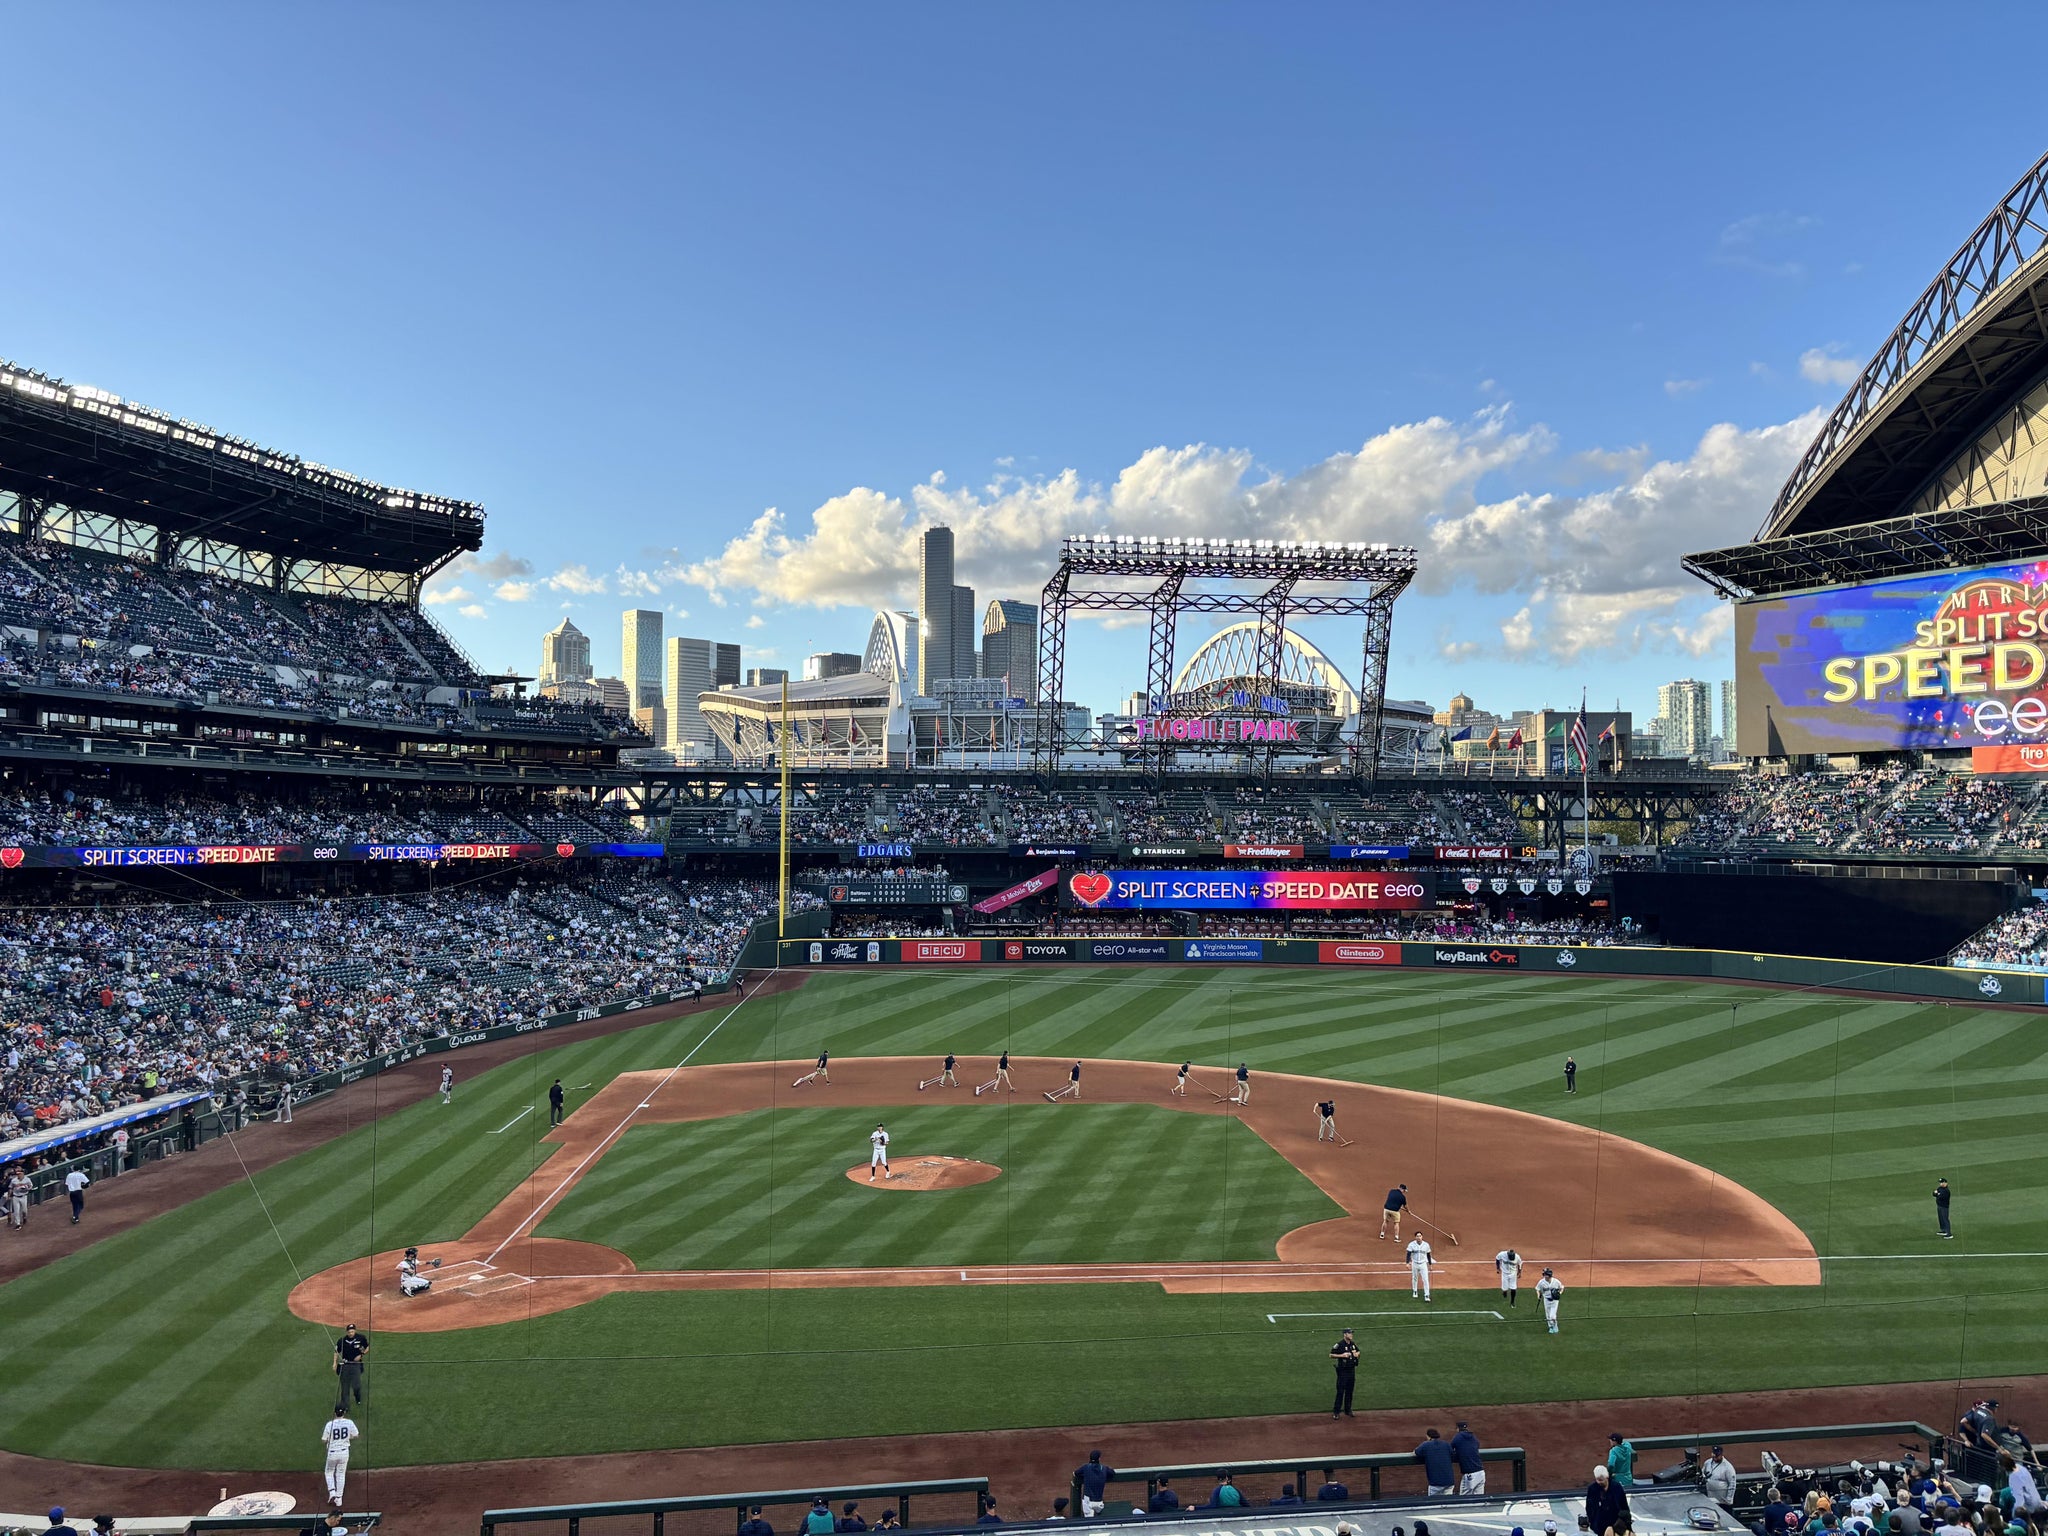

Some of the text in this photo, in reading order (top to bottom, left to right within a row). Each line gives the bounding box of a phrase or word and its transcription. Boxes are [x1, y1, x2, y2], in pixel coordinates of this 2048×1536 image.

[1916, 612, 2010, 647] SPLIT
[1824, 642, 2046, 702] SPEED
[1233, 690, 1289, 716] MARINERS
[514, 709, 537, 718] Trident
[1134, 719, 1300, 741] T-MOBILE PARK
[2020, 747, 2043, 759] fire
[84, 848, 275, 866] SPLIT SCREEN SPEED DATE
[314, 847, 338, 859] eero
[369, 846, 510, 860] SPLIT SCREEN SPEED DATE
[858, 845, 912, 857] EDGARS
[1007, 888, 1026, 900] Mobile
[1026, 879, 1042, 892] Pen
[1118, 882, 1424, 899] SPLIT SCREEN SPEED DATE eero
[831, 946, 858, 959] Miller
[1026, 946, 1067, 955] TOYOTA
[1094, 945, 1125, 955] eero
[1436, 950, 1488, 963] KeyBank
[1560, 952, 1572, 960] 50
[1983, 980, 1997, 988] 50
[577, 1007, 601, 1021] STIHL
[516, 1020, 548, 1032] Great Clips
[460, 1032, 486, 1044] LEXUS
